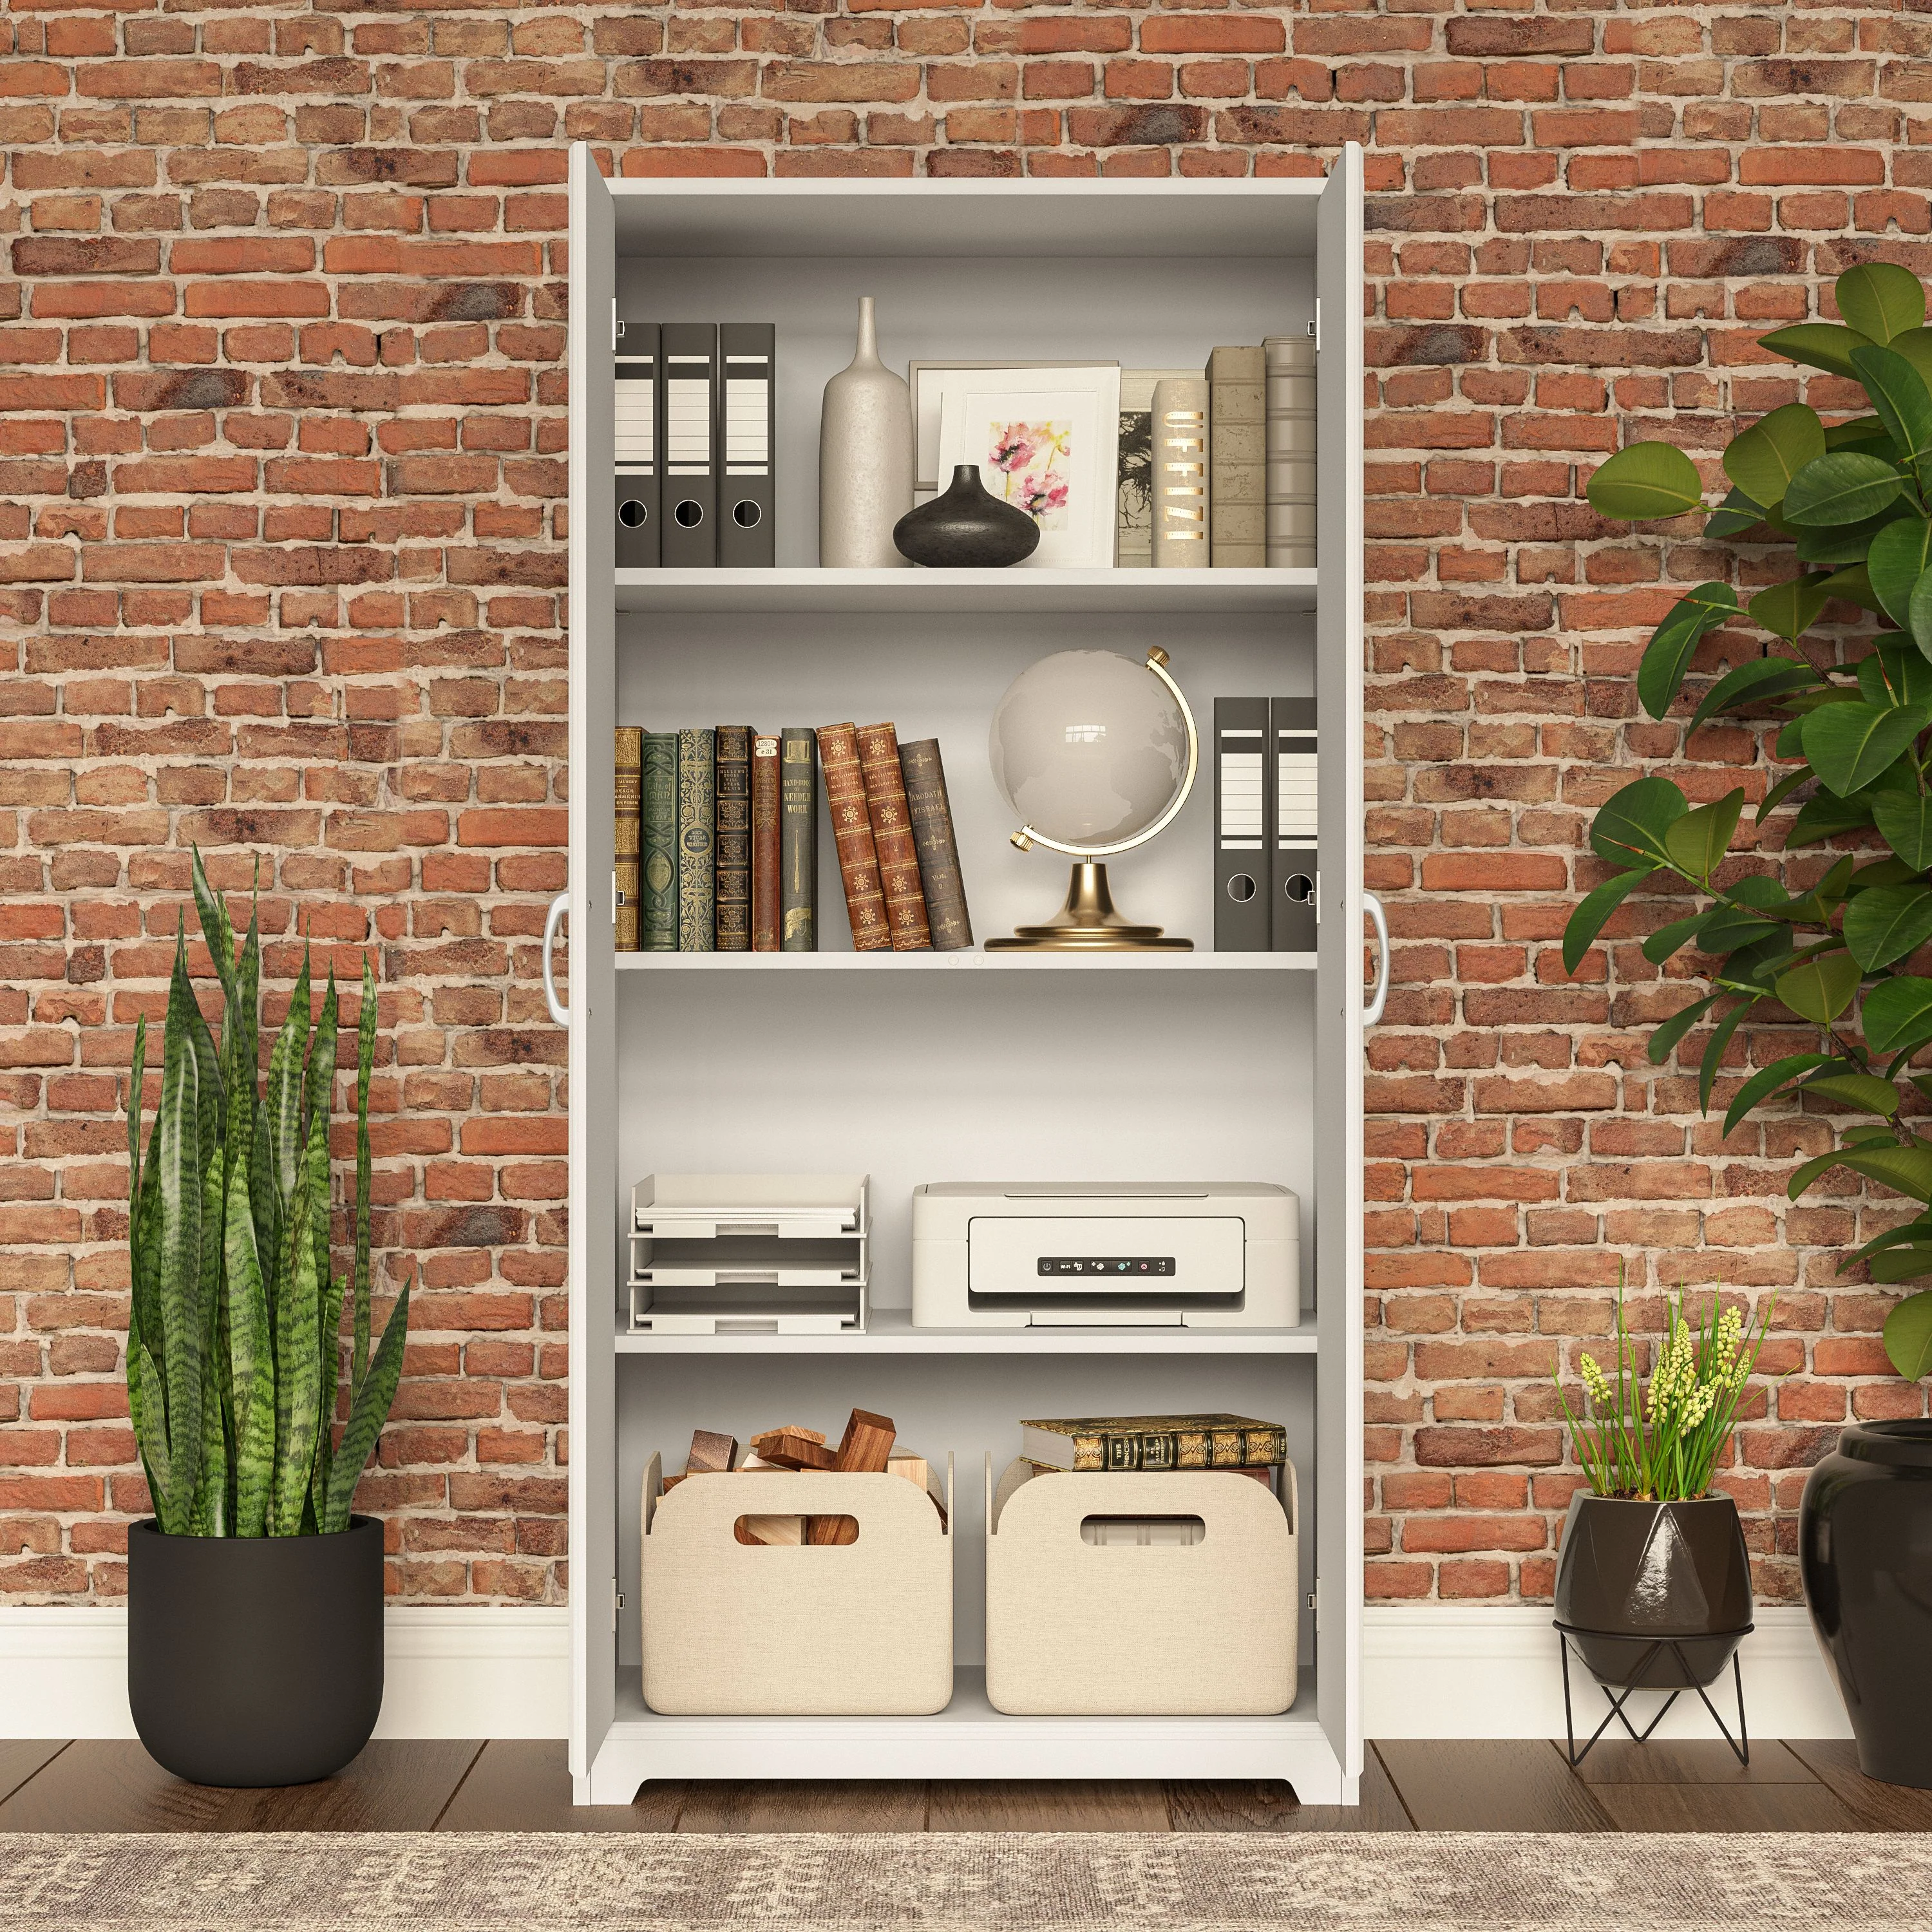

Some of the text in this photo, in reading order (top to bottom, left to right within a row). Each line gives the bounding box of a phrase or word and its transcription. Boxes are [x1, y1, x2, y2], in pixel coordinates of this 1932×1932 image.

[1162, 412, 1204, 540] UFFIZI
[784, 792, 811, 801] NEEDLE
[787, 805, 808, 813] WORK
[914, 804, 945, 814] YISRAEL
